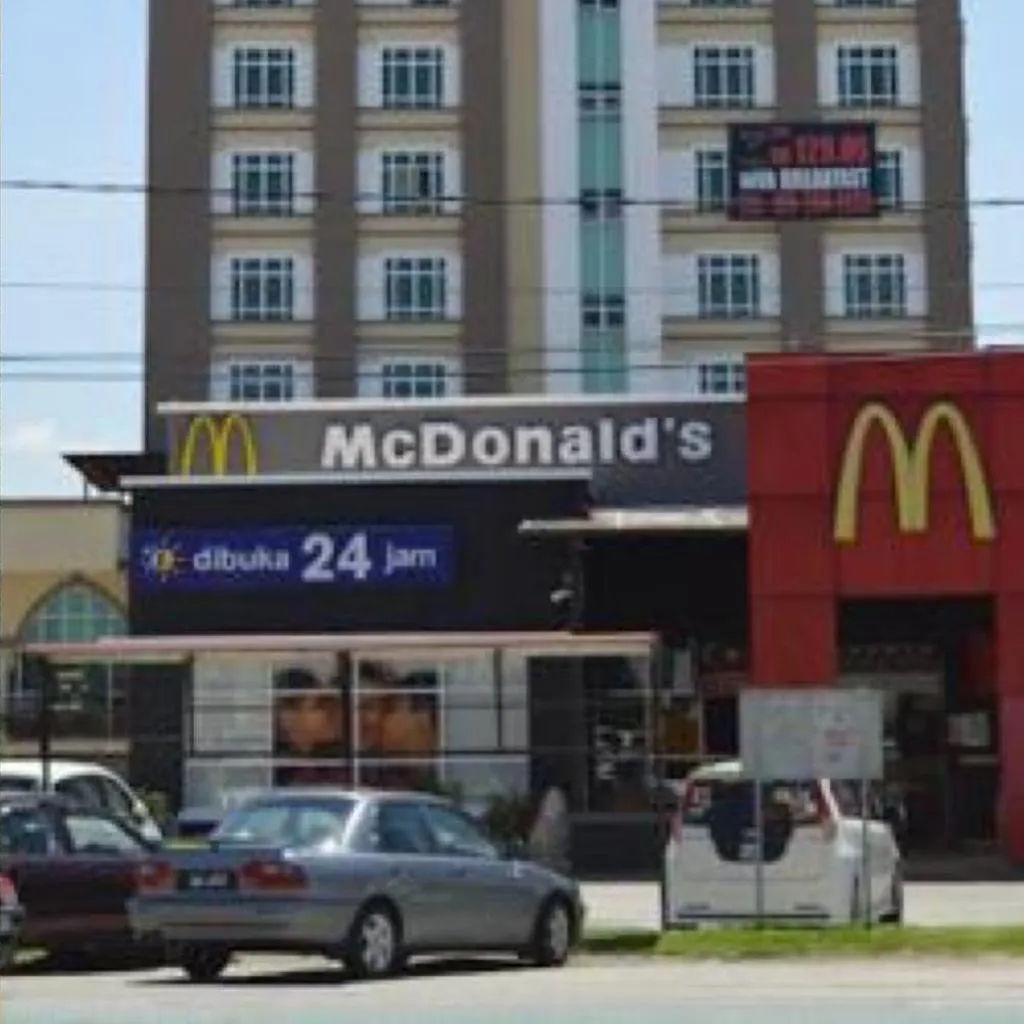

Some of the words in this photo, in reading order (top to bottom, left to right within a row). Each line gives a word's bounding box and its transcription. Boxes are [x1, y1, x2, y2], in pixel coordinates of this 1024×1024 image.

[180, 414, 258, 477] M
[320, 416, 713, 469] McDonald's
[834, 401, 996, 543] M
[192, 546, 290, 572] dibuka
[301, 532, 372, 582] 24
[384, 540, 437, 576] jam
